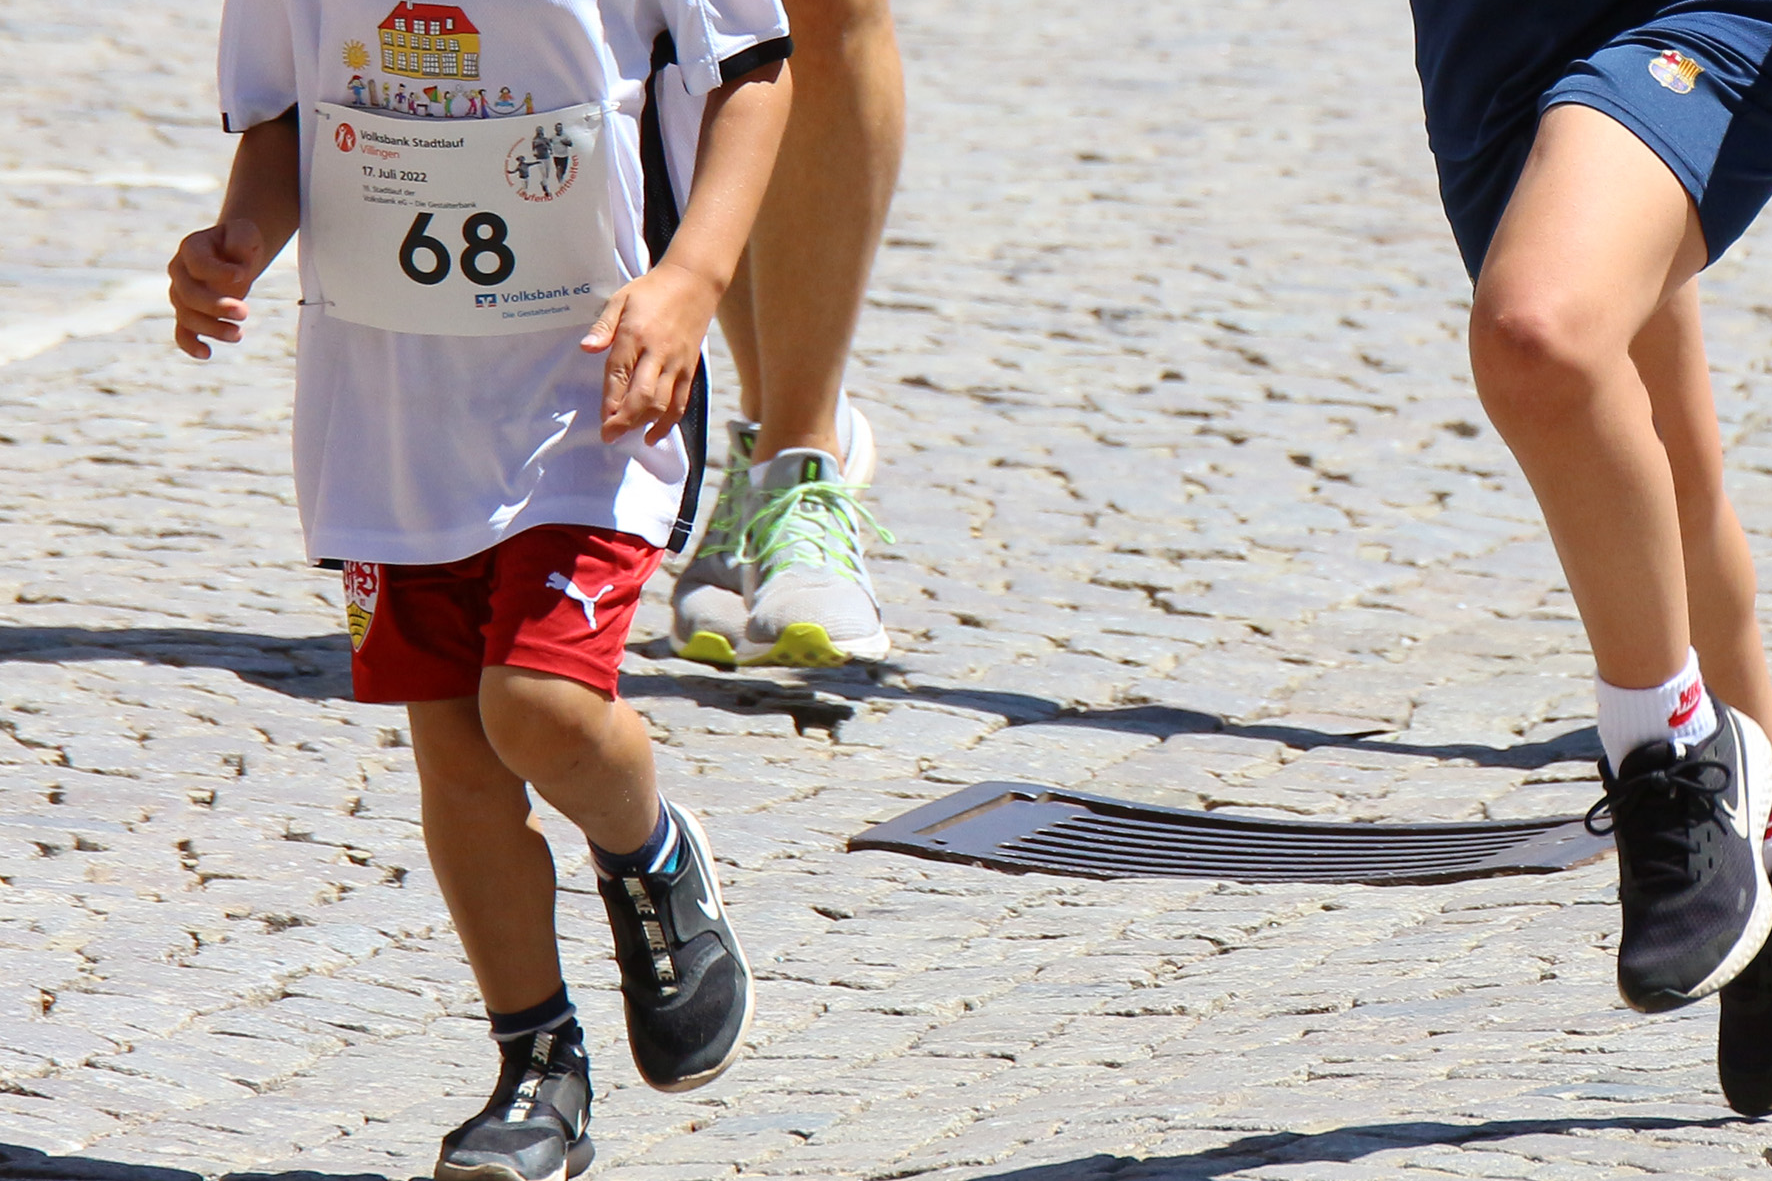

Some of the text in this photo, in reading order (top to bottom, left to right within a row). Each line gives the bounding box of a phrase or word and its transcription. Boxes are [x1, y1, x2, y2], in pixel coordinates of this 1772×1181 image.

[360, 129, 464, 149] Volksbank Stadtlauf
[360, 144, 400, 160] Villingen
[362, 165, 428, 183] 17. Juli 2022
[399, 211, 515, 286] 68
[501, 283, 591, 303] Volksbank eG
[502, 311, 515, 319] Die
